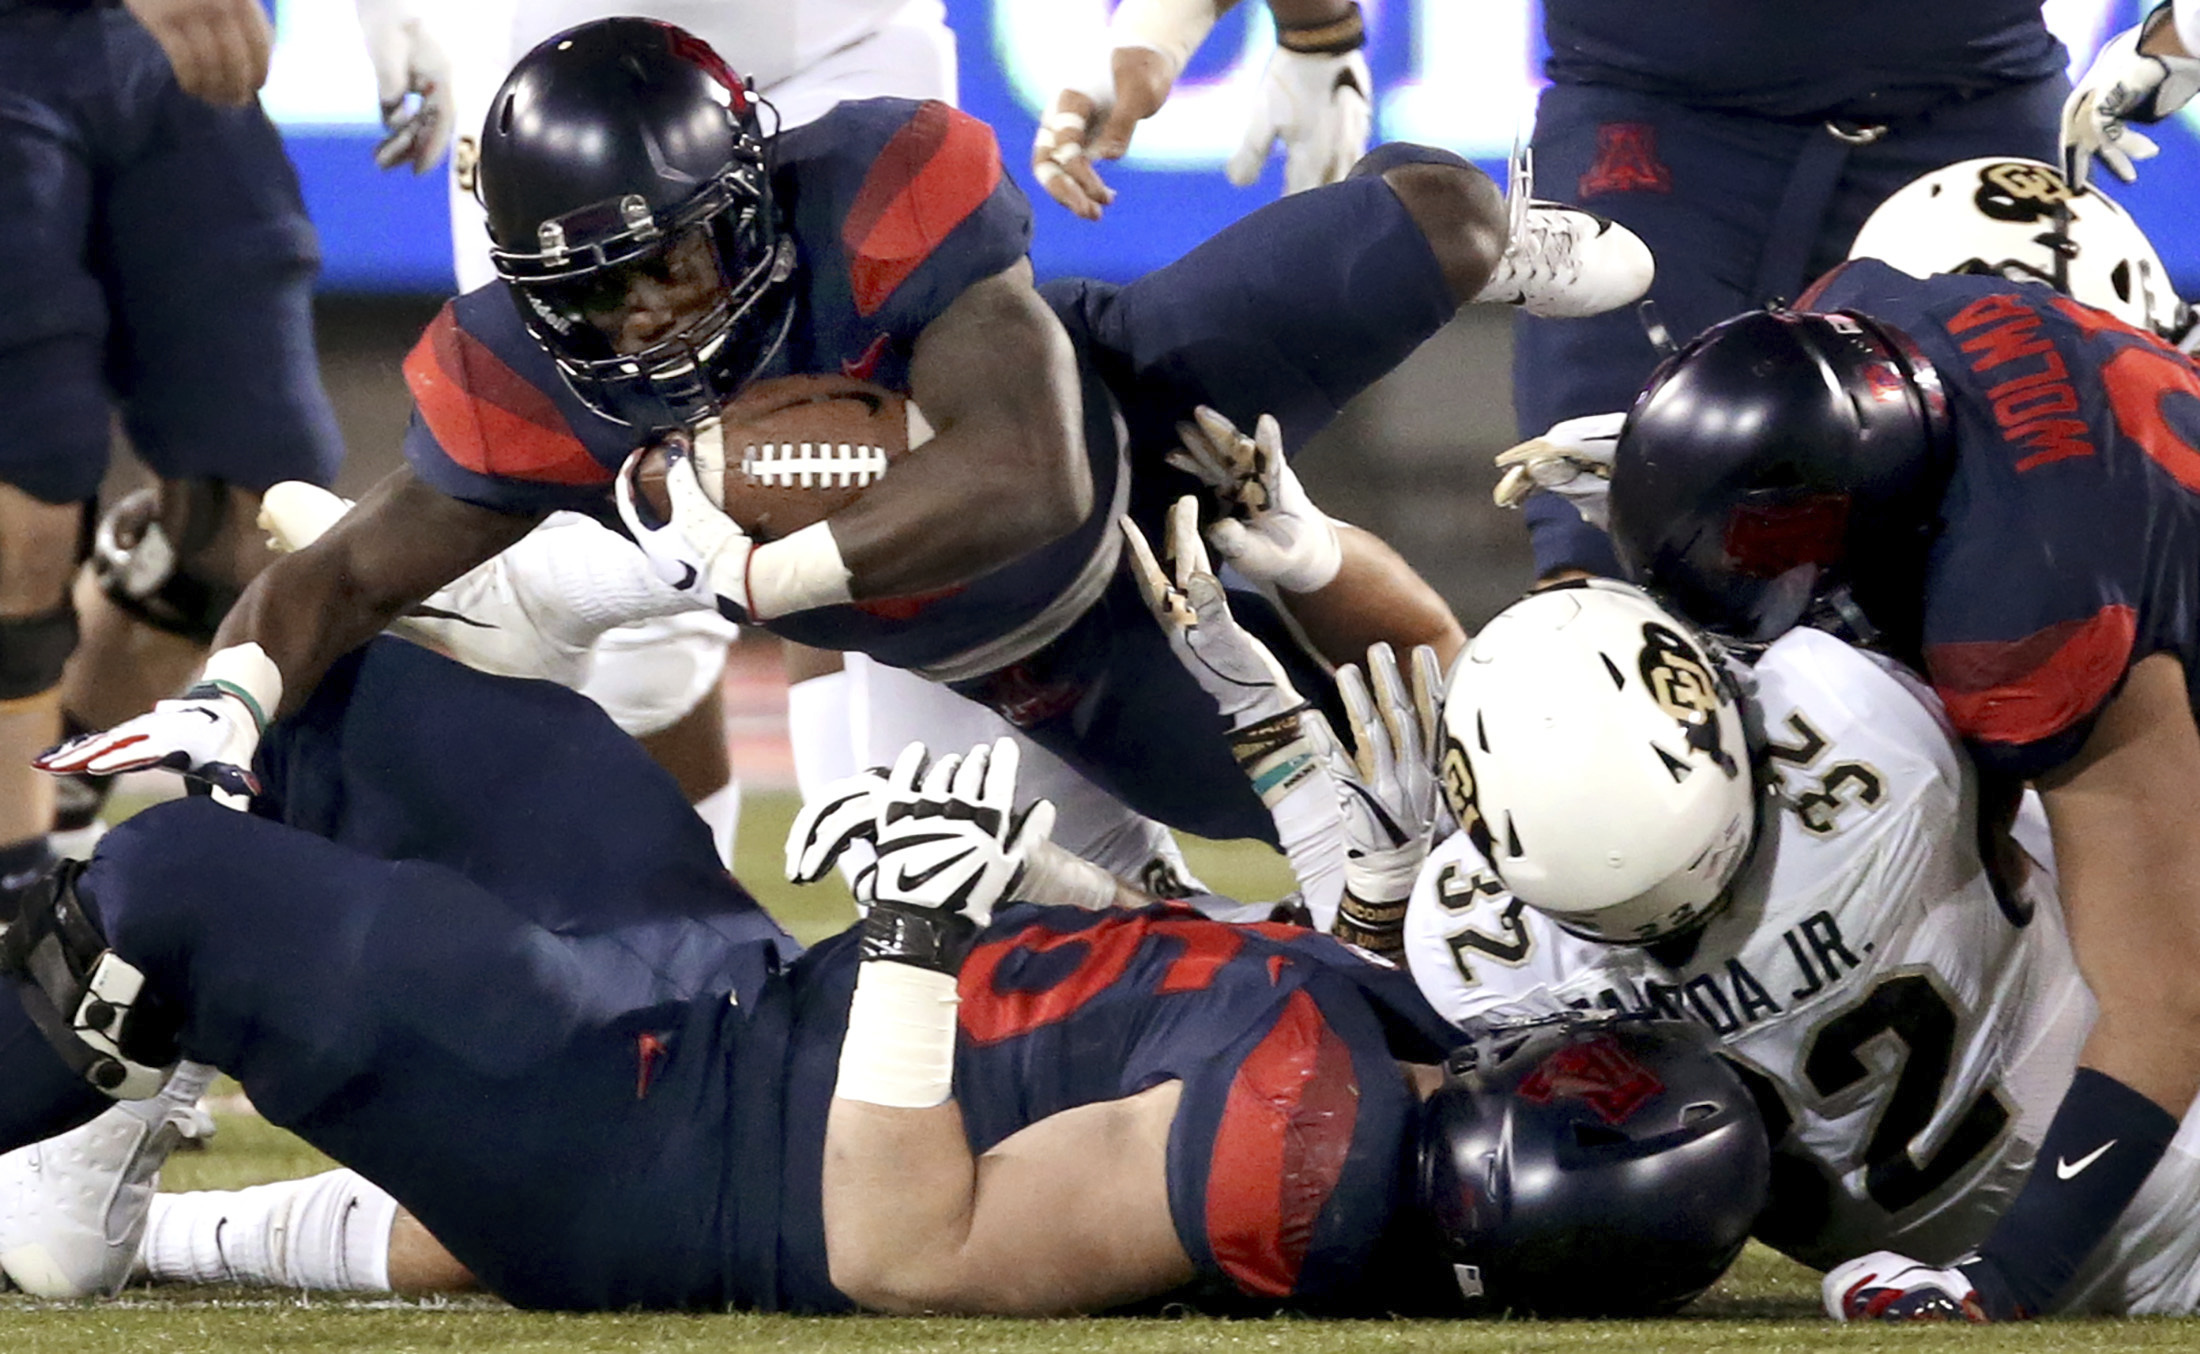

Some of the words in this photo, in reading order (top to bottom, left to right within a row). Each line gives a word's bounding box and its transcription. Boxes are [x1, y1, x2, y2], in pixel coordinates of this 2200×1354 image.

[1577, 122, 1673, 198] A
[1946, 293, 2096, 474] WOLMA
[1435, 859, 1538, 988] 32
[1783, 911, 1876, 1000] JR.
[1722, 964, 2020, 1215] 2
